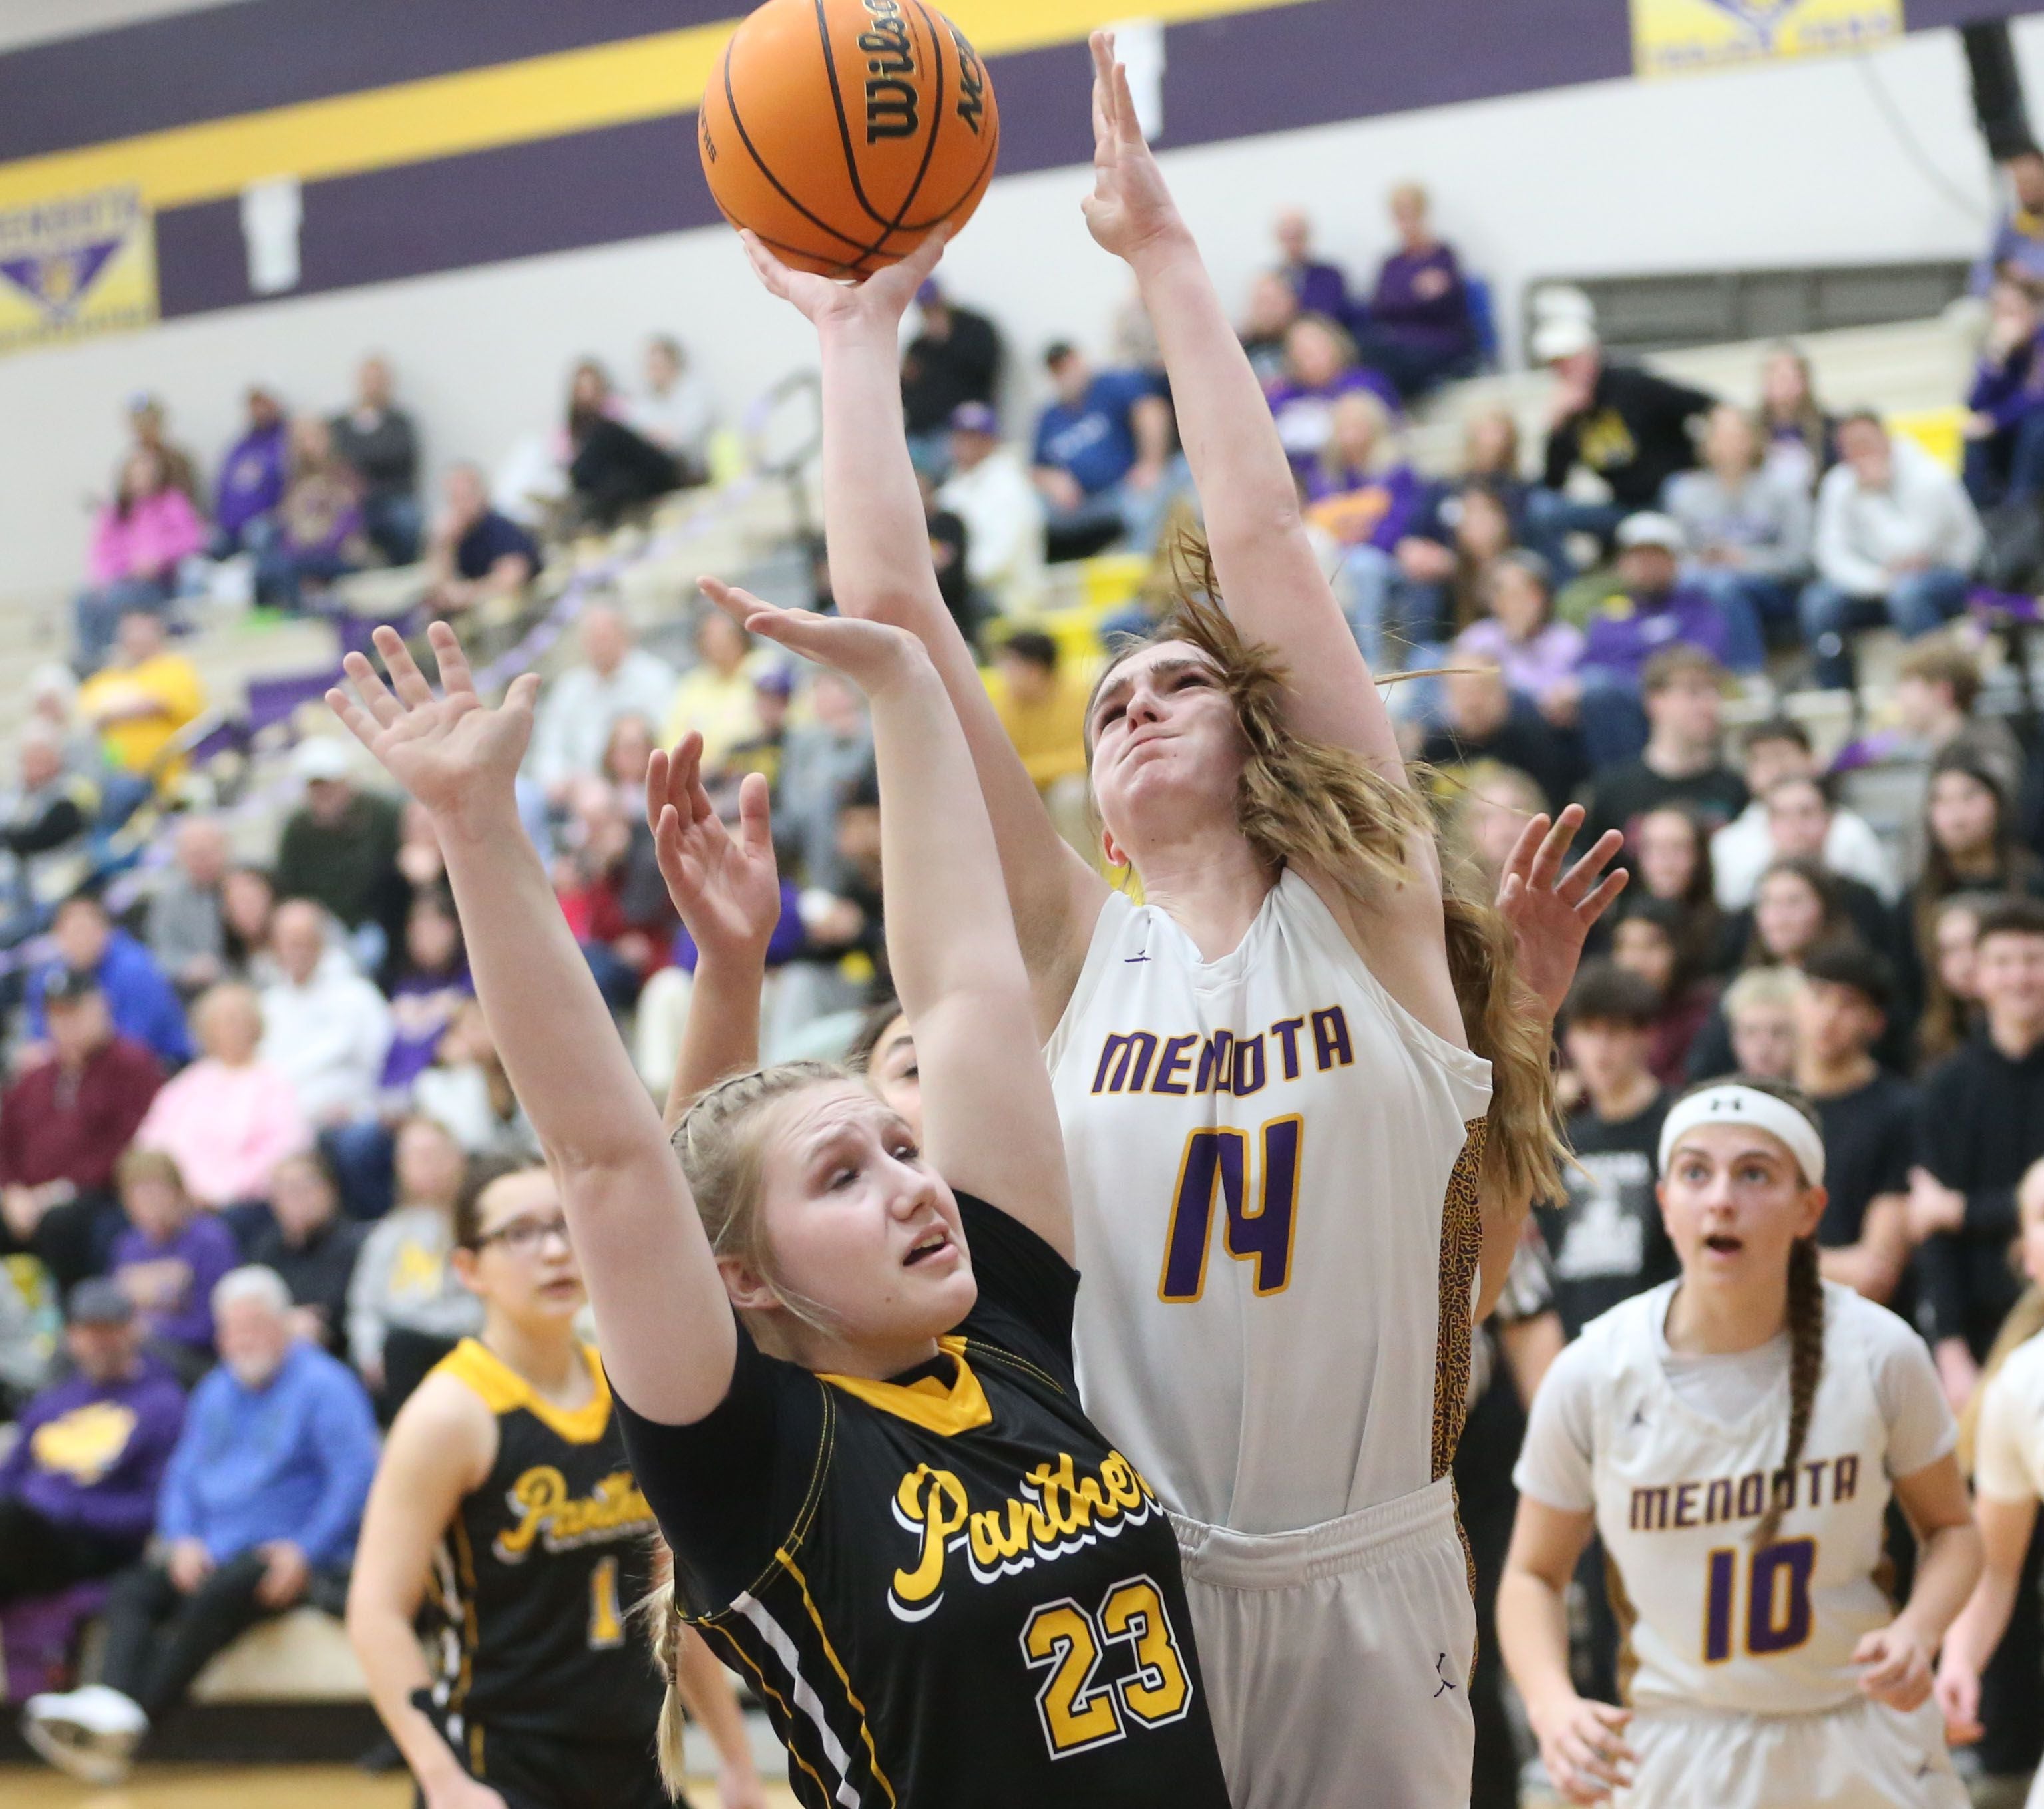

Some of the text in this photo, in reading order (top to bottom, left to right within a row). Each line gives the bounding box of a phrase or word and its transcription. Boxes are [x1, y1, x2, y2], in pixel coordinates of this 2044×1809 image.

[1157, 1113, 1304, 1303] 14
[587, 1555, 627, 1651] 1
[1019, 1573, 1193, 1761] 23
[1702, 1534, 1818, 1667] 10
